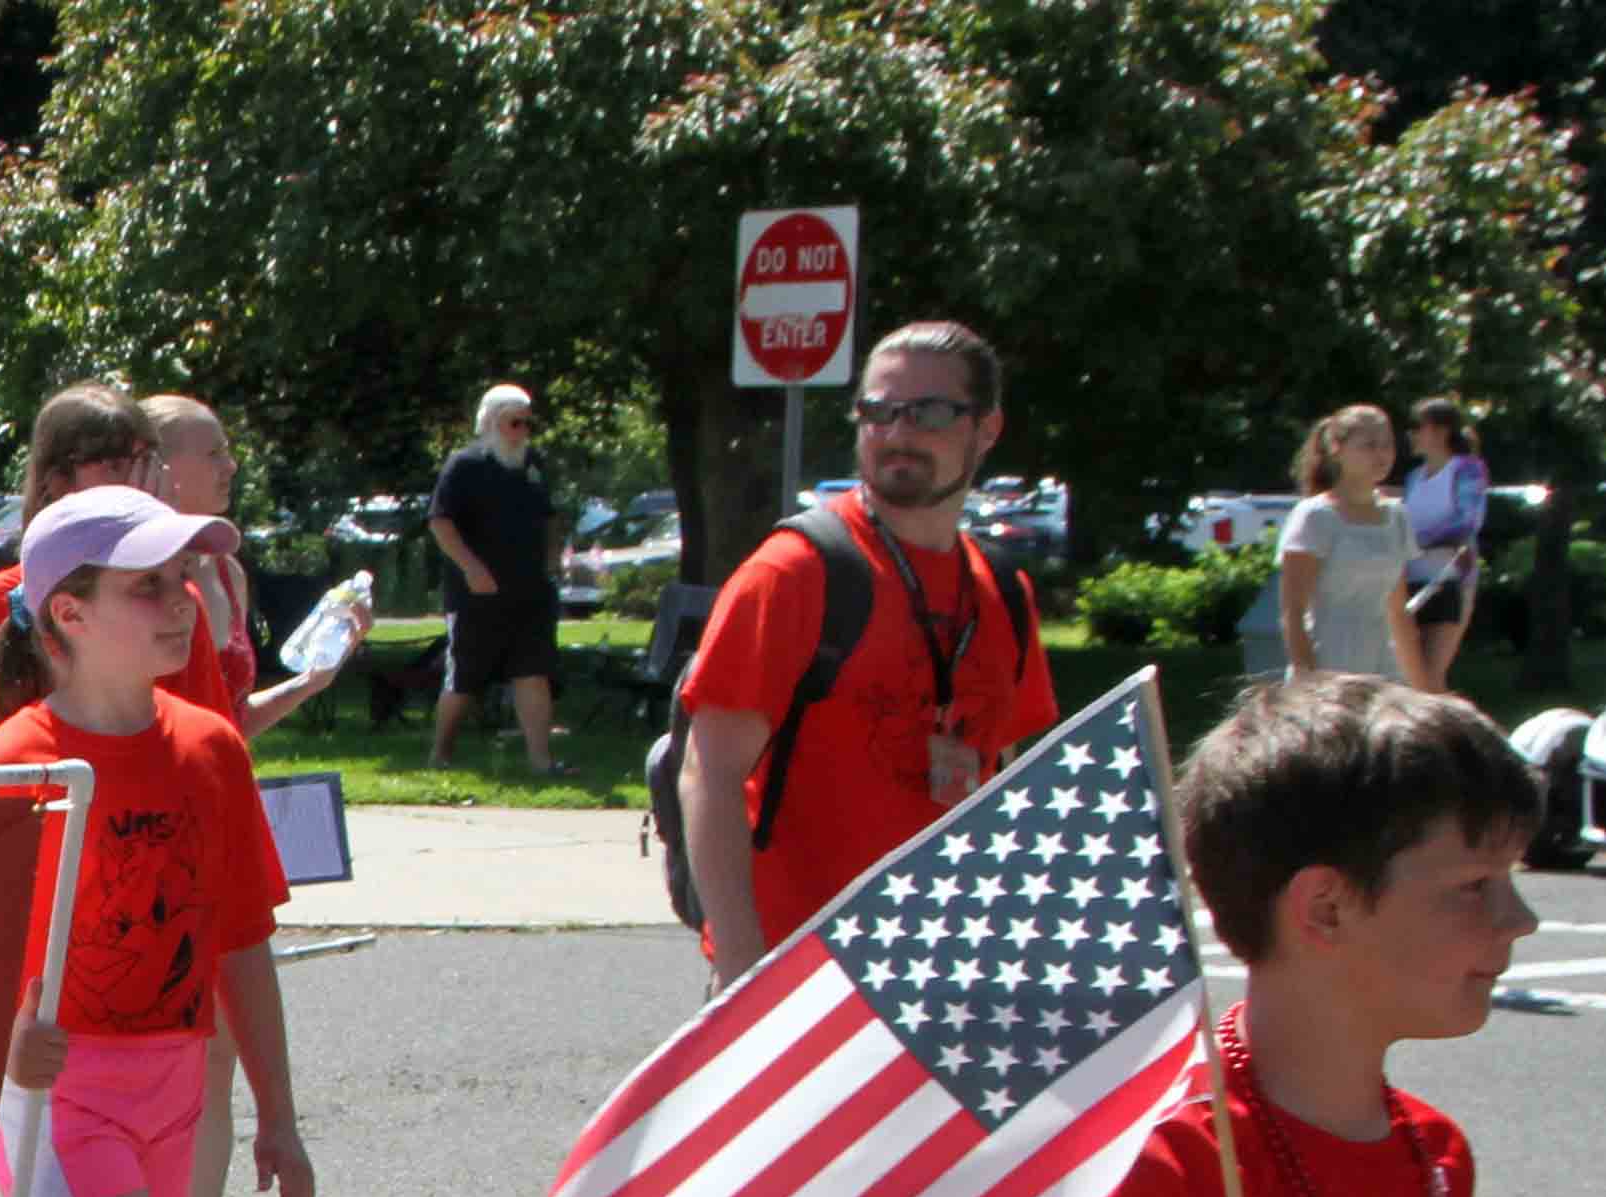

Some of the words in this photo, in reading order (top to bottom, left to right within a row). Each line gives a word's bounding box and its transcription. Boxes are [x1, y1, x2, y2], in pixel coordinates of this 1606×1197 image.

[755, 247, 787, 273] DO
[796, 244, 839, 272] NOT
[760, 317, 827, 349] ENTER
